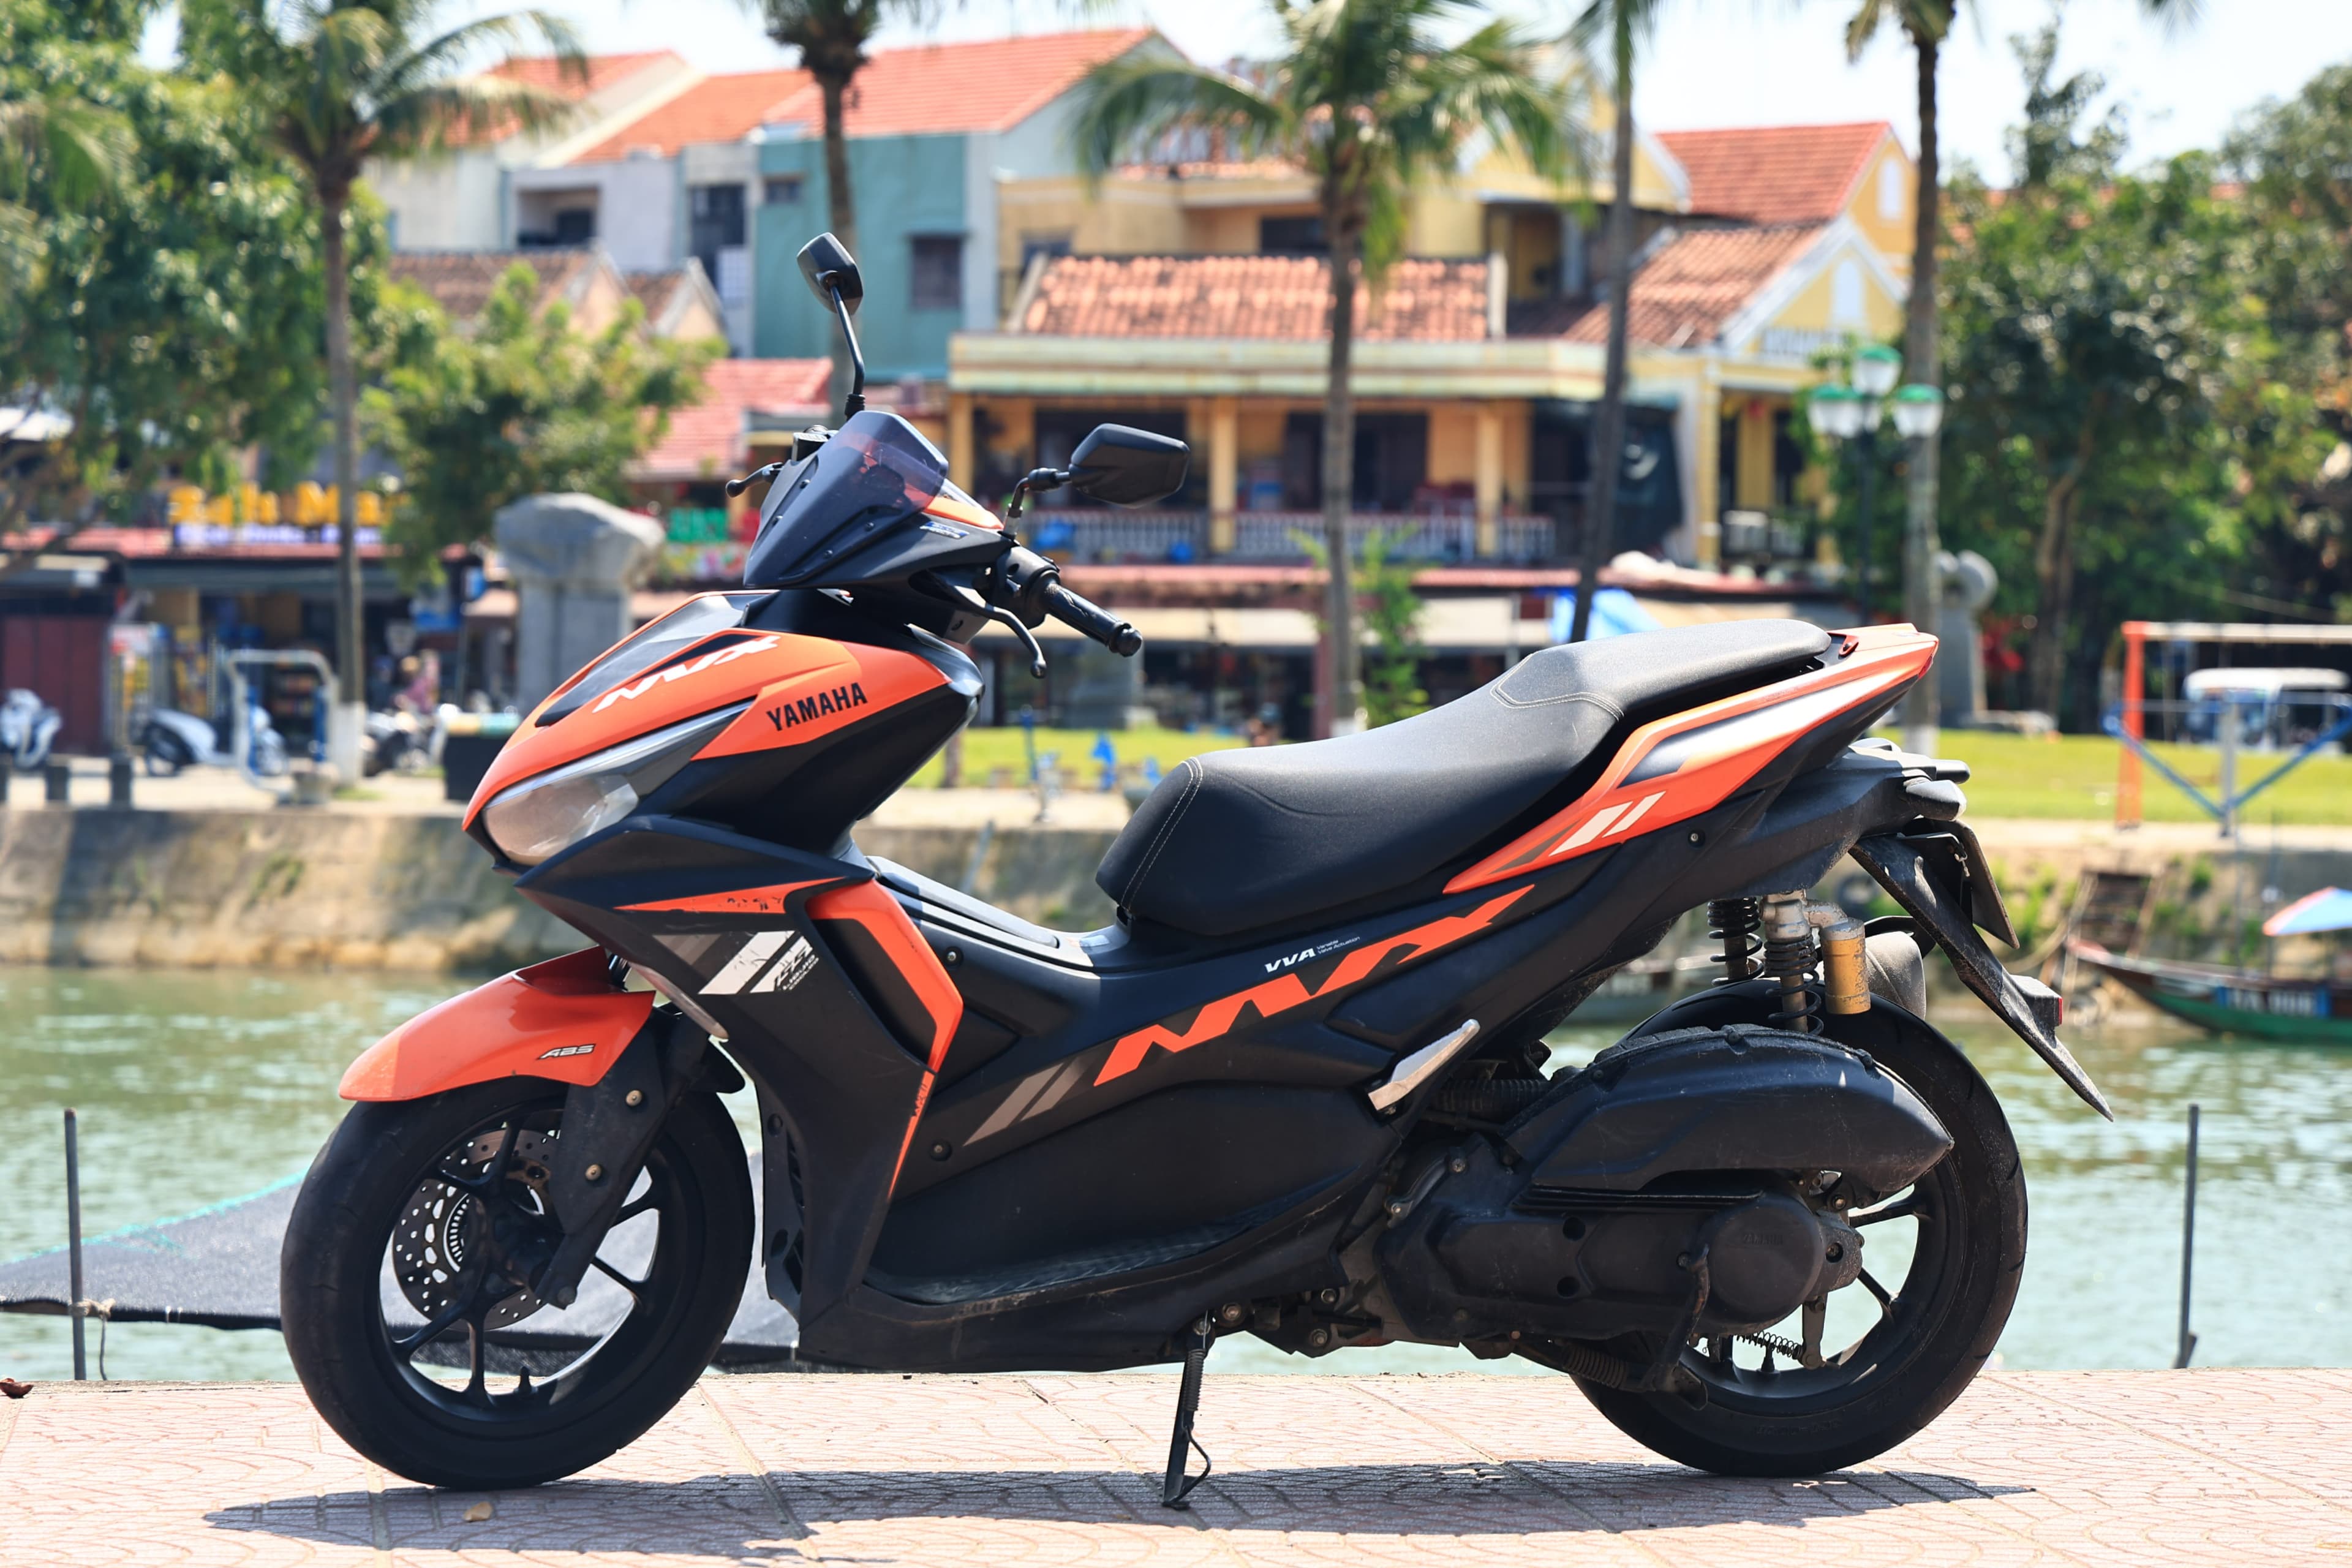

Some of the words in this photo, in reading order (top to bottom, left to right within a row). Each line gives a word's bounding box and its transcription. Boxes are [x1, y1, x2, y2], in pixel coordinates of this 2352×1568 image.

[766, 682, 868, 731] YAMAHA
[1333, 936, 1360, 949] Actuation
[1264, 948, 1316, 973] VVA
[538, 1044, 596, 1059] ABS
